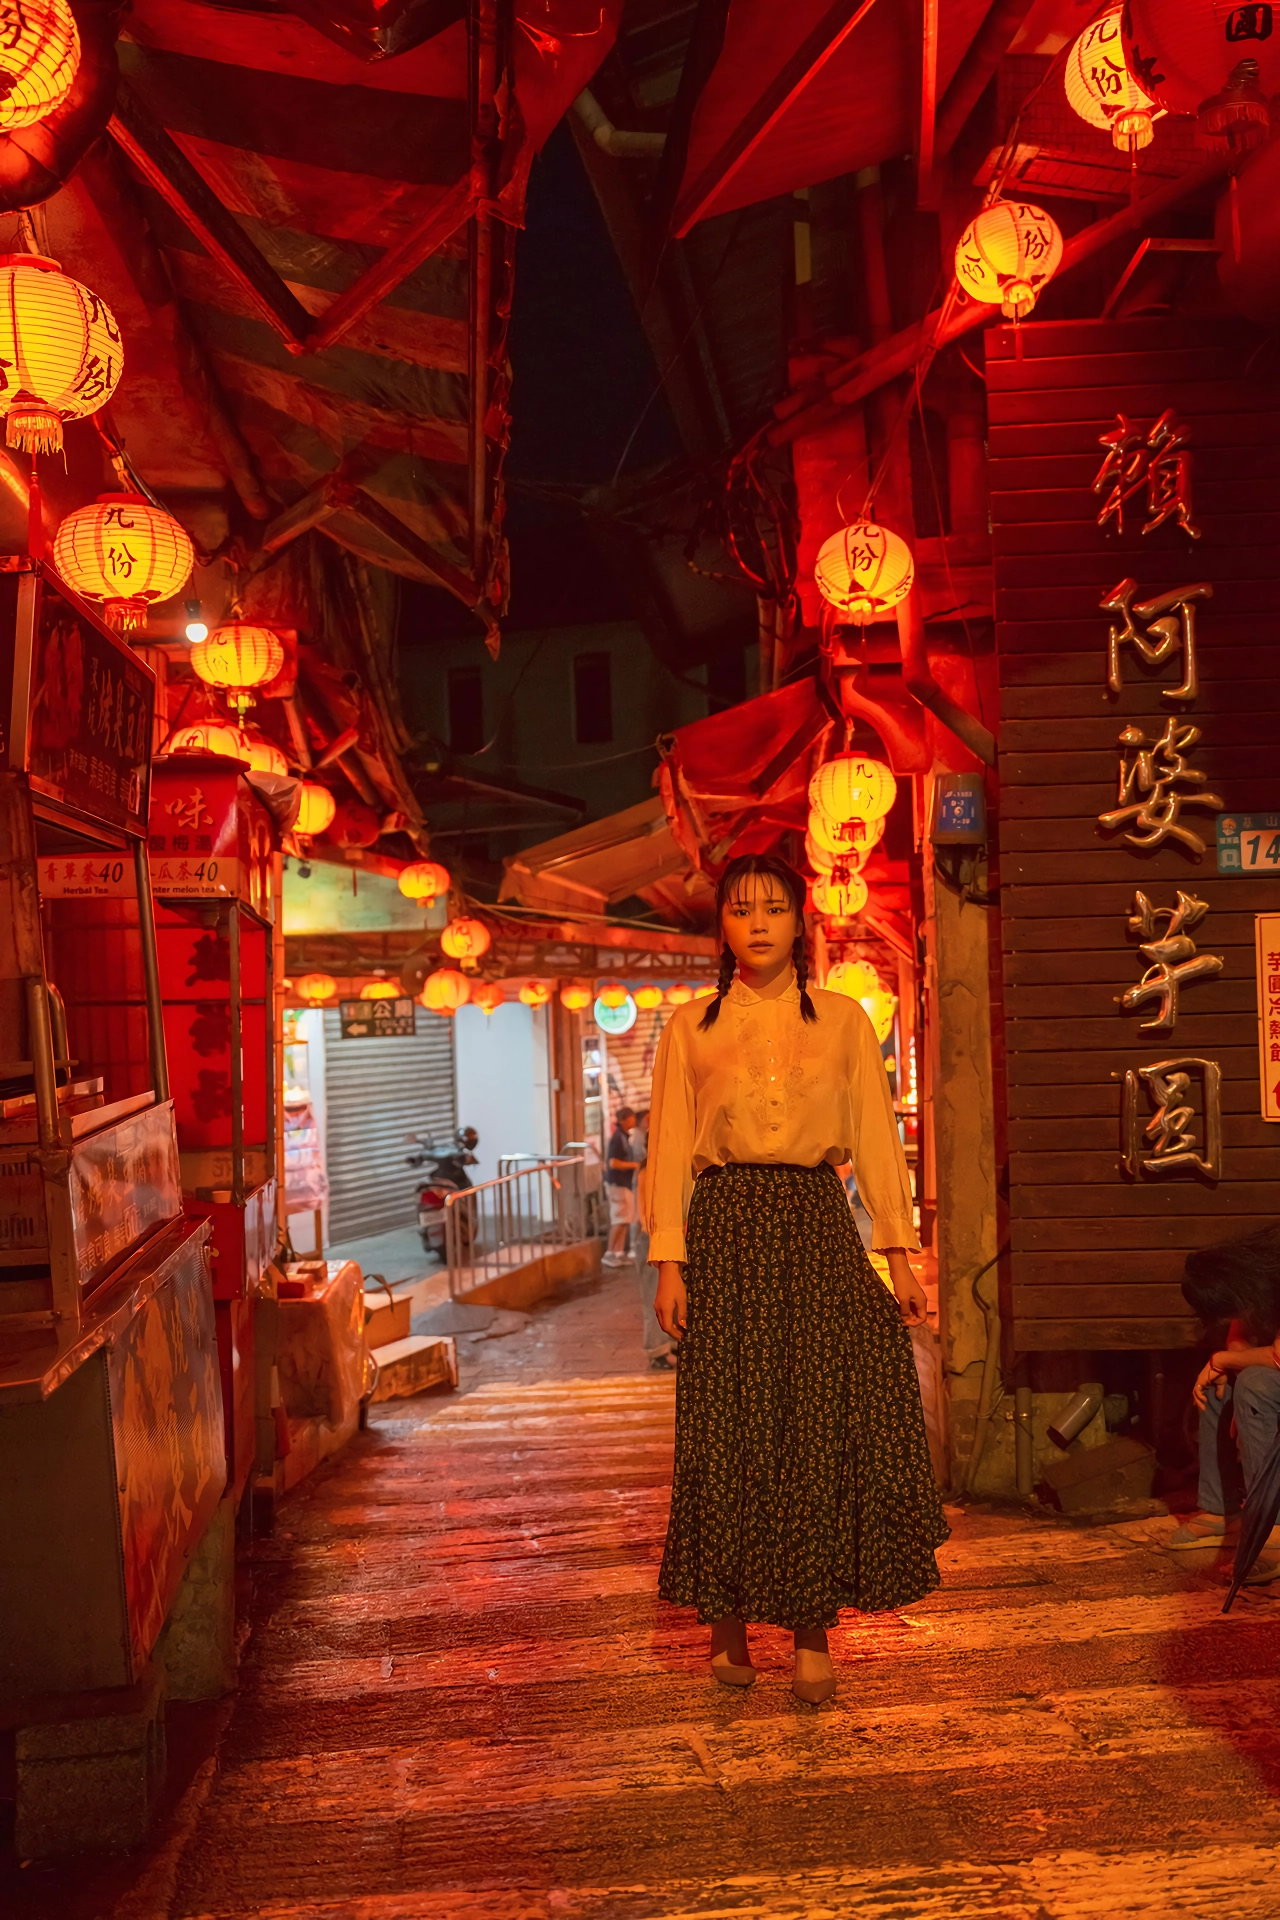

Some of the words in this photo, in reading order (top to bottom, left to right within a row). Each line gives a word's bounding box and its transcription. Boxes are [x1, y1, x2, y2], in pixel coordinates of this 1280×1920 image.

[1085, 18, 1126, 97] 九份
[1019, 205, 1049, 260] 九份
[73, 289, 120, 401] 九份
[104, 507, 138, 578] 九份
[850, 526, 879, 571] 九份
[151, 787, 214, 830] 味
[63, 887, 92, 895] Herbal
[99, 862, 123, 883] 40
[150, 861, 193, 881] 瓜茶
[194, 861, 219, 882] 40
[152, 885, 170, 893] nter
[172, 885, 199, 893] melon
